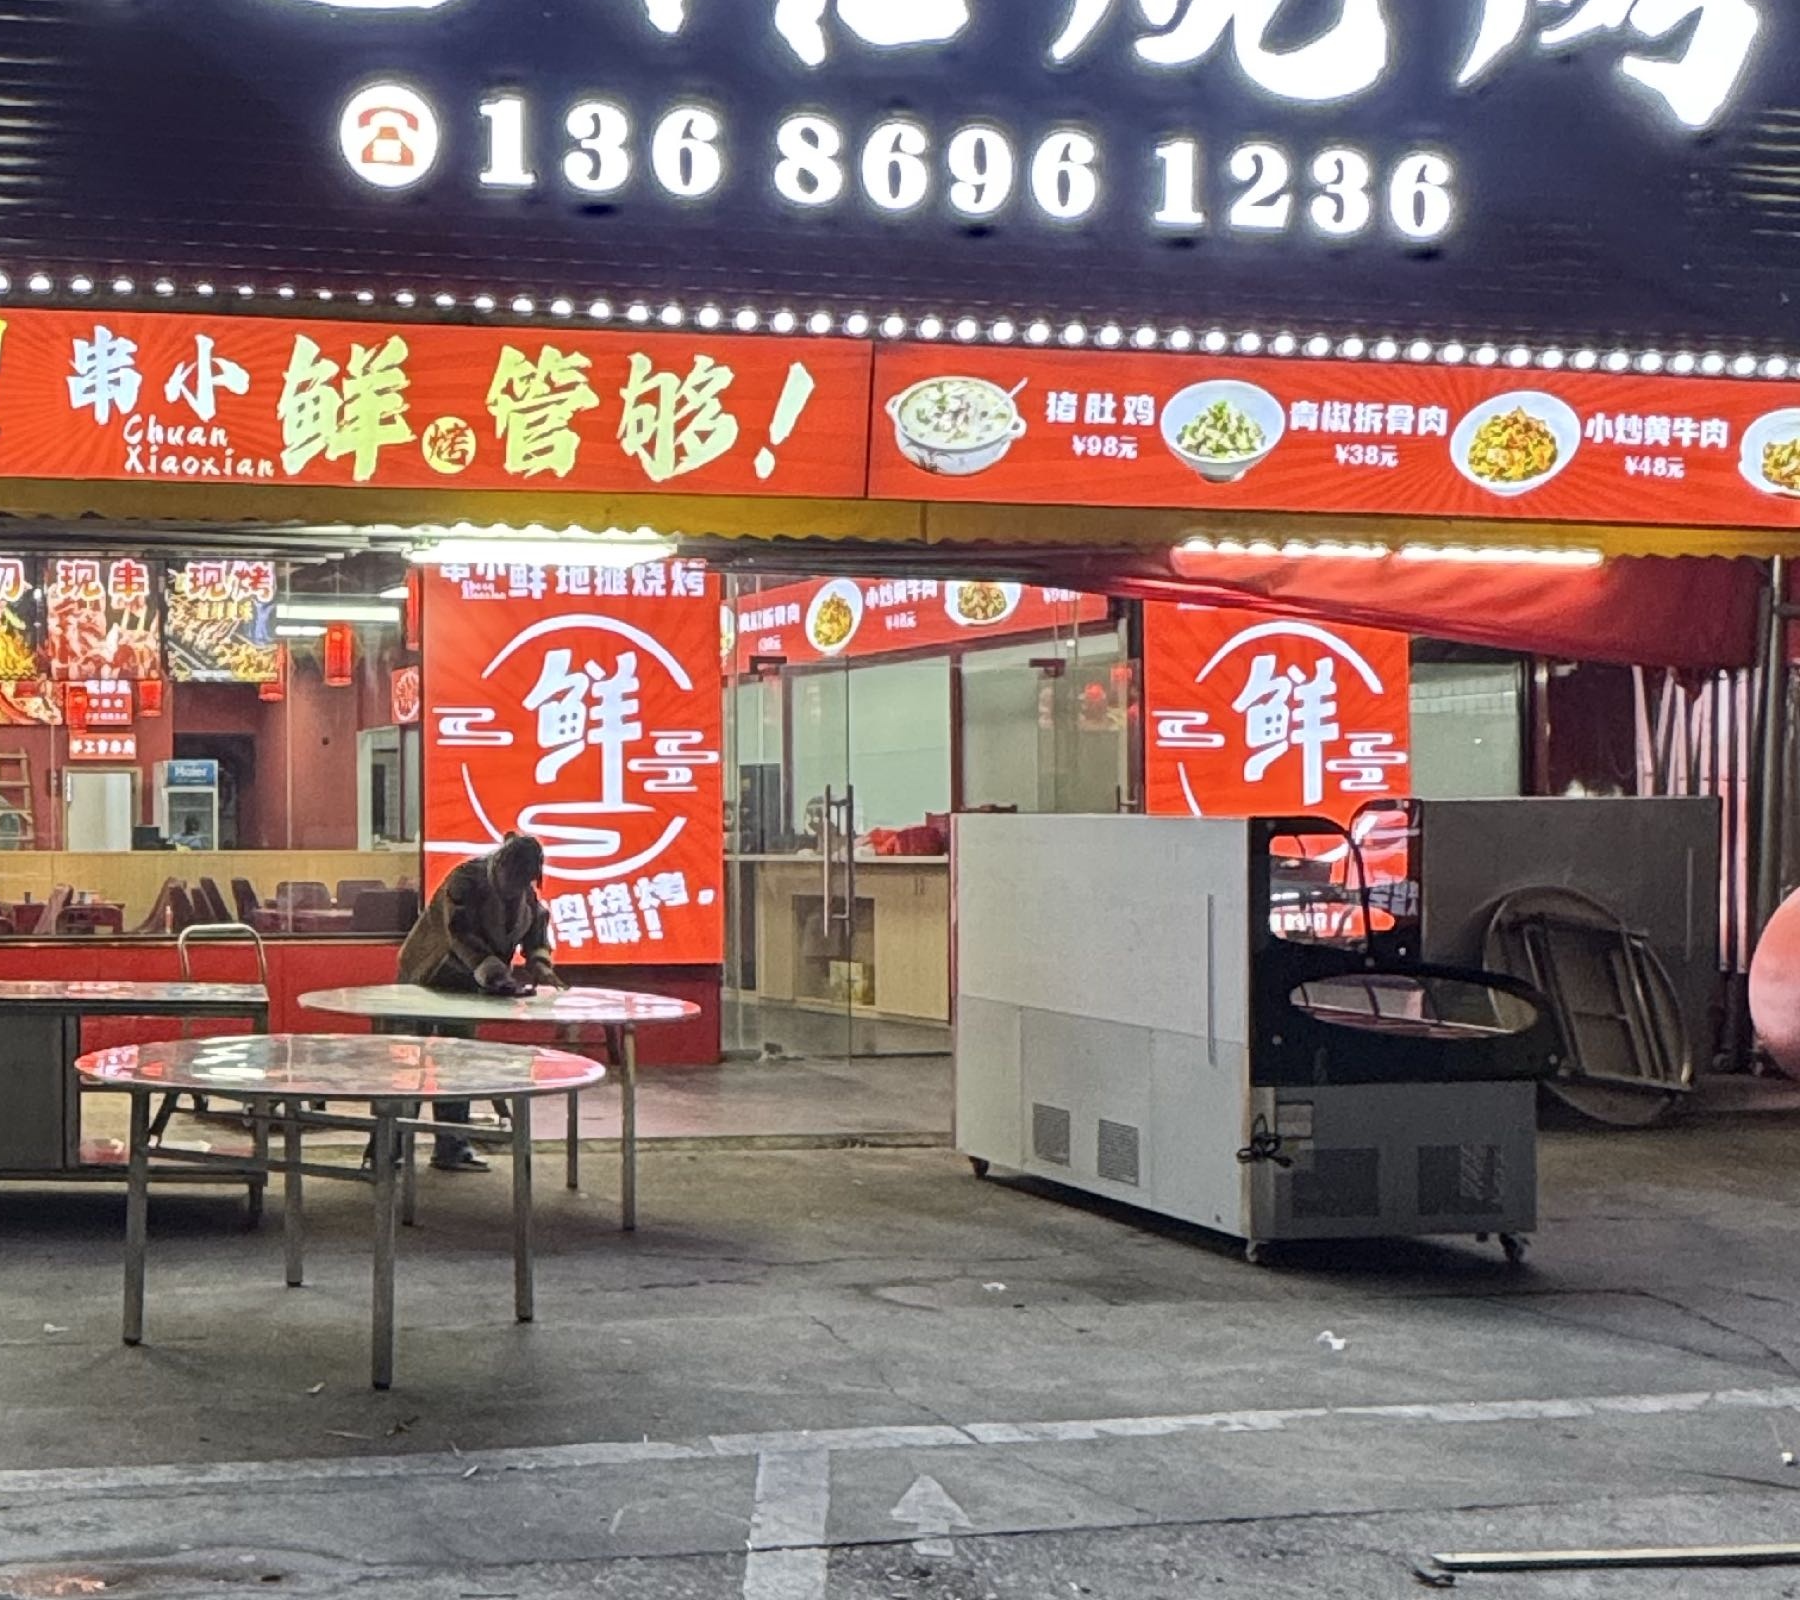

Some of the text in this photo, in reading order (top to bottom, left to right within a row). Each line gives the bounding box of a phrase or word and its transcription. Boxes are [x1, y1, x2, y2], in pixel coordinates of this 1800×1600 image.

[478, 96, 1454, 239] 136 8696 1236
[1045, 391, 1156, 427] 猪肚鸡
[1289, 401, 1449, 437] 青椒拆骨肉
[122, 414, 229, 447] Chuan
[1072, 434, 1139, 460] ¥98元
[1584, 412, 1729, 449] 小炒黄牛肉
[124, 444, 275, 478] Xiaoxian
[1334, 443, 1399, 468] ¥38元
[1624, 455, 1686, 479] ¥48元
[57, 558, 150, 601] 现串
[186, 560, 274, 601] 现烤
[522, 648, 642, 808] 鲜
[1231, 654, 1340, 806] 鲜
